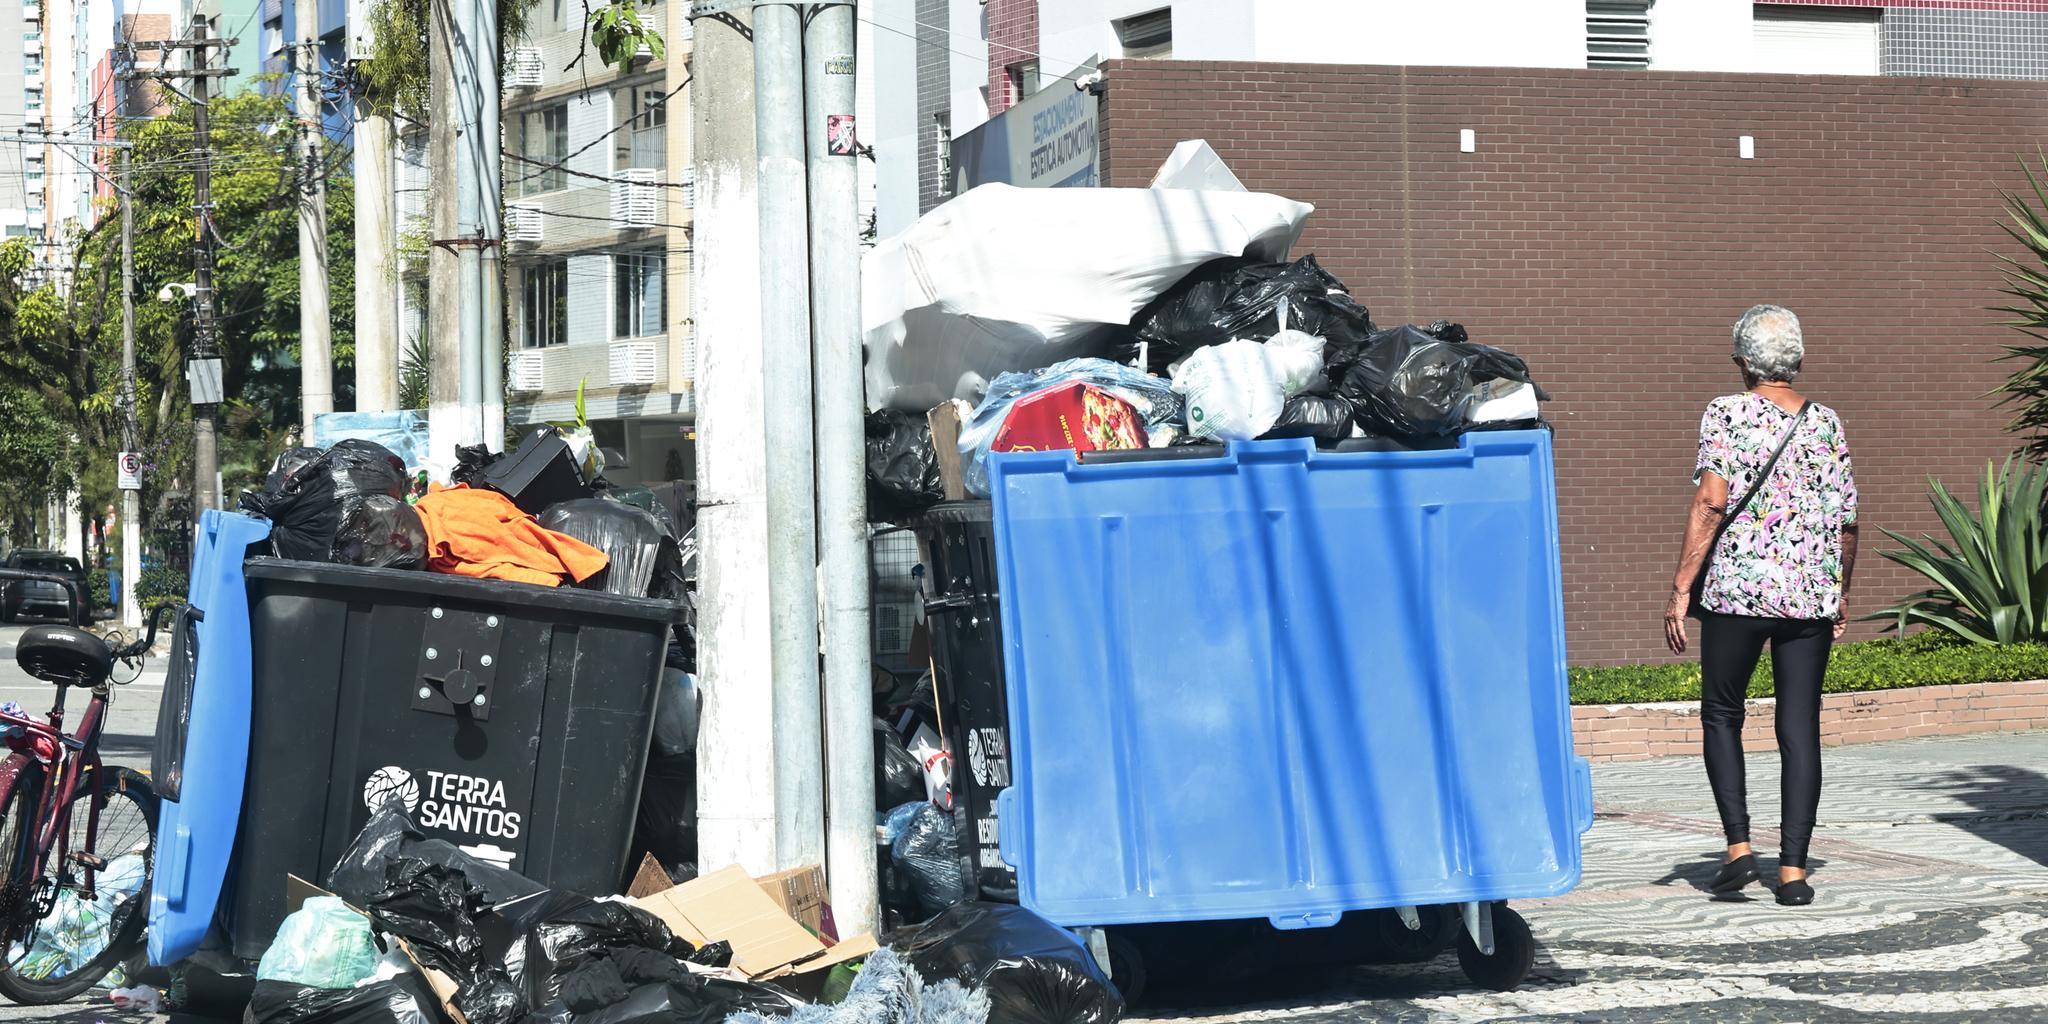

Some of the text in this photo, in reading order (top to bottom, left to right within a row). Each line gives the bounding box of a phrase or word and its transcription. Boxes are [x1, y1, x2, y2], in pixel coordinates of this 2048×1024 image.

[981, 727, 1006, 755] TERRA
[427, 770, 507, 808] TERRA
[419, 800, 521, 839] SANTOS
